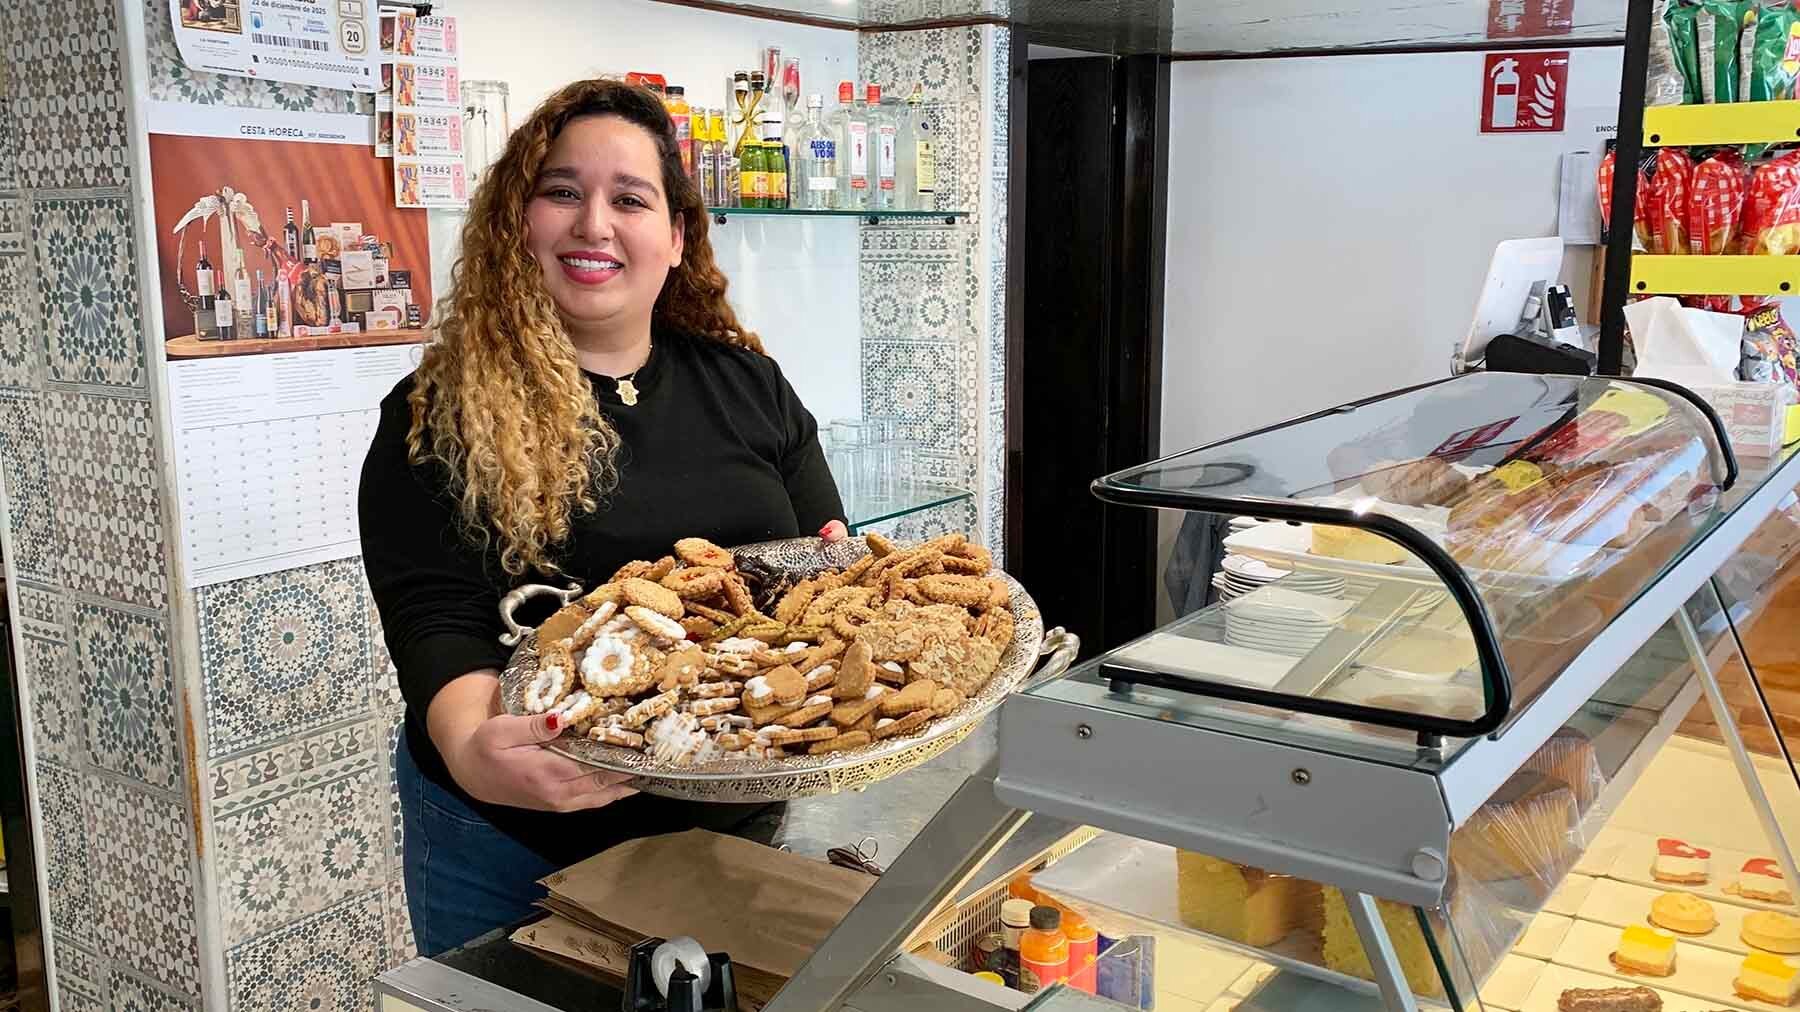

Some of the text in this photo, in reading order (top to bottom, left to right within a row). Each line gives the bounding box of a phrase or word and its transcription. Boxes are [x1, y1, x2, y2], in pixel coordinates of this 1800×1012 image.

[312, 7, 327, 15] 2025
[418, 16, 445, 28] 14342
[346, 30, 360, 42] 20
[417, 66, 446, 78] 14342
[418, 116, 448, 127] 14342
[240, 125, 266, 136] CESTA
[269, 127, 304, 137] HORECA
[420, 165, 451, 176] 14342
